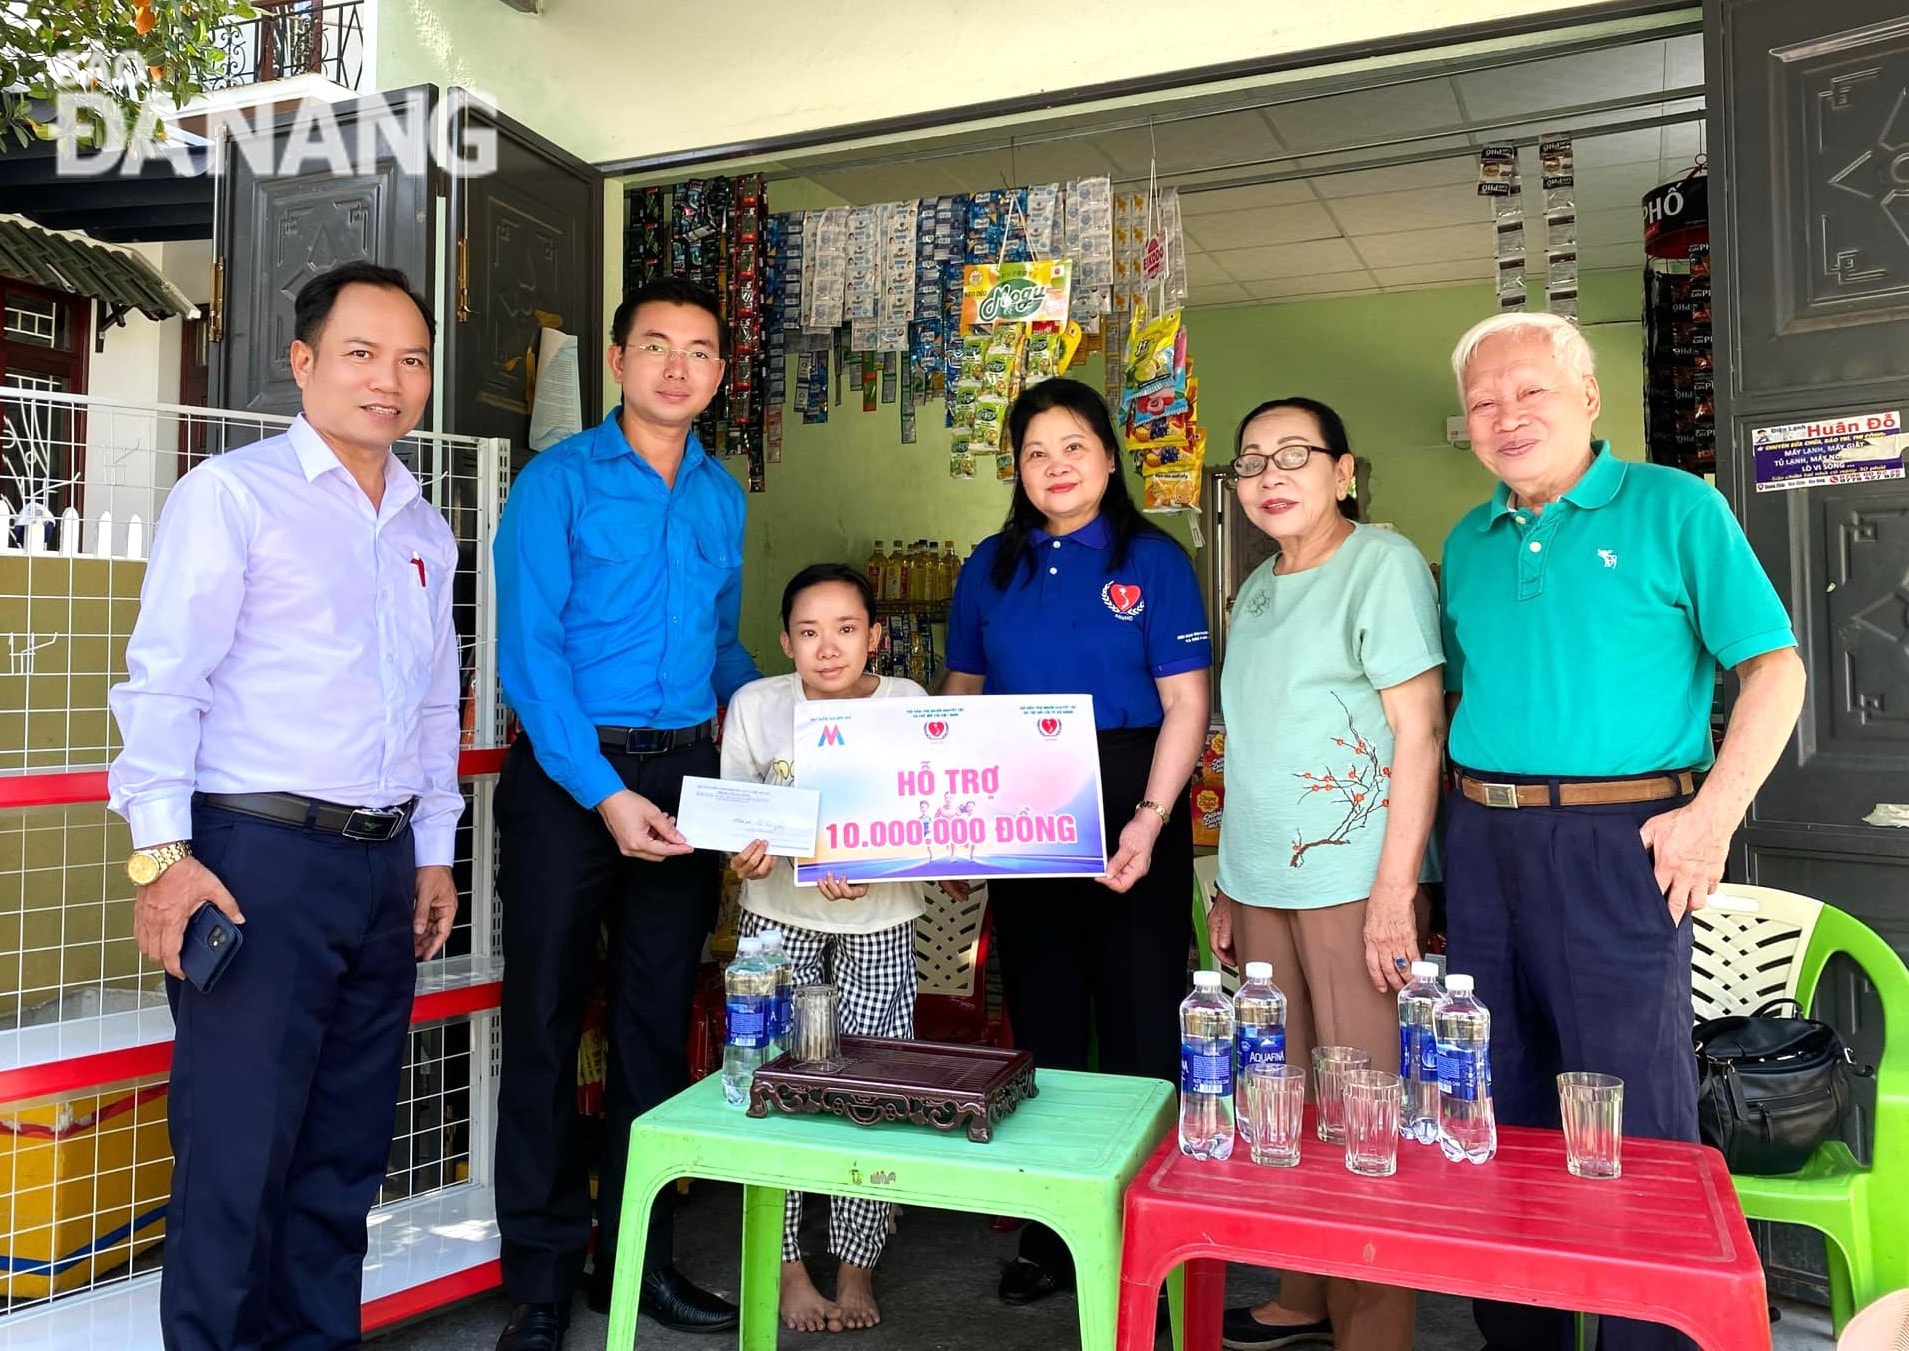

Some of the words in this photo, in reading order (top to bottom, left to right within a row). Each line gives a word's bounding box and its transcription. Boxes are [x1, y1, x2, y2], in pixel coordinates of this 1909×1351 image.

[1807, 421, 1859, 438] Huân
[1866, 413, 1896, 430] Đỗ
[1784, 447, 1802, 457] MÁY
[897, 760, 935, 797] HỖ
[944, 765, 1000, 800] TRỢ
[826, 817, 986, 849] 10.000.000
[995, 807, 1077, 843] ĐỒNG
